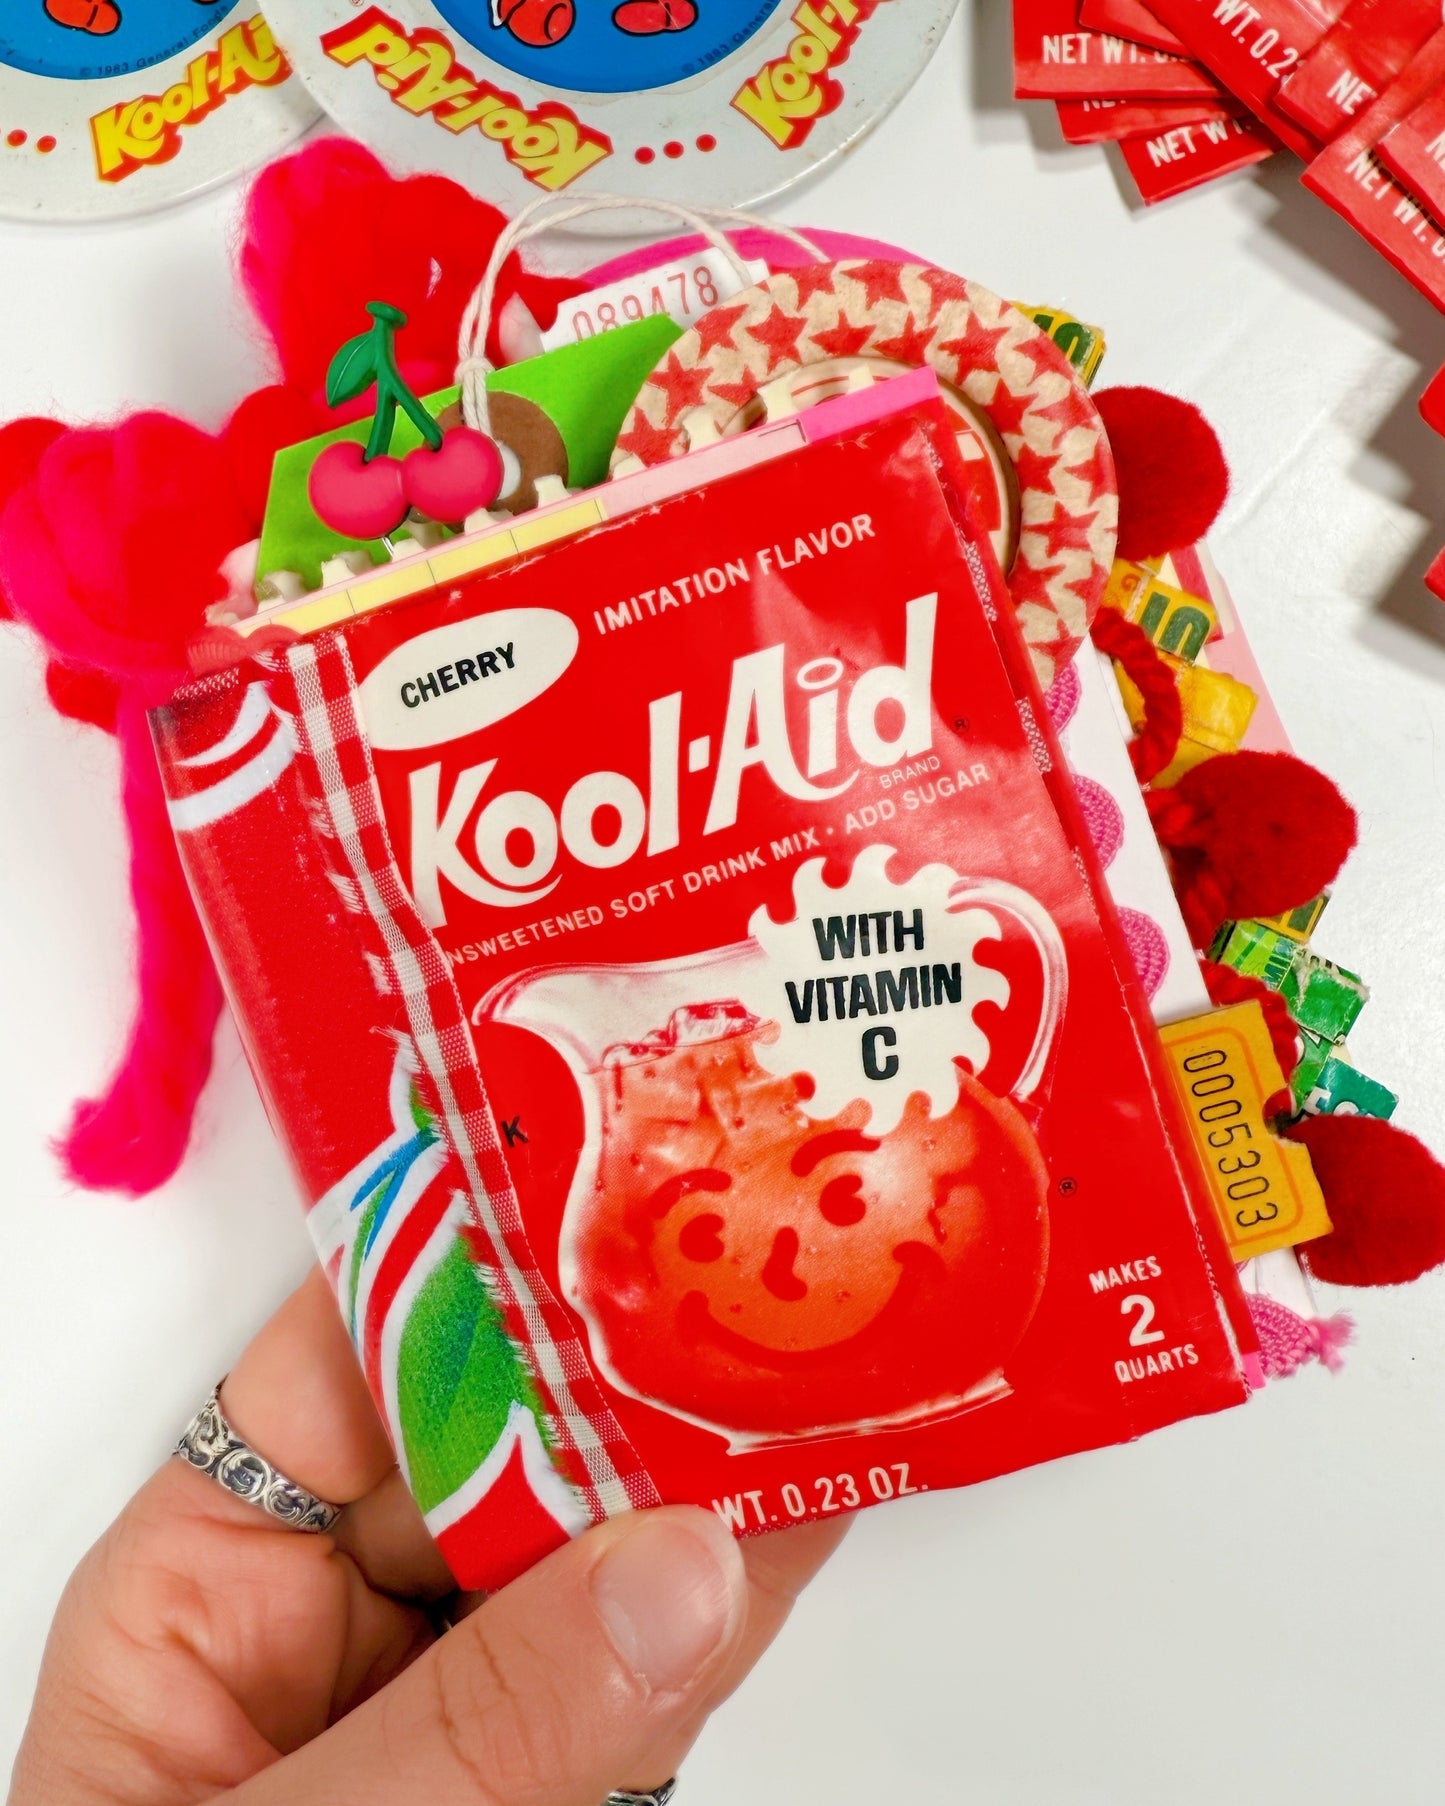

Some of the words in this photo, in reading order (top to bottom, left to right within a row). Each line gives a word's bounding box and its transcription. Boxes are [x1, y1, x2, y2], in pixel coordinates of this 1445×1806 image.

[97, 61, 130, 76] 1983
[135, 38, 190, 68] General
[191, 5, 228, 39] Foods
[1042, 32, 1092, 64] NET
[1212, 0, 1262, 44] WT.
[1250, 28, 1306, 87] 0.2
[92, 12, 290, 181] Kool-Ai
[321, 8, 612, 191] Kool-Aid
[1326, 69, 1378, 116] NE
[1146, 126, 1197, 168] NET
[593, 556, 748, 636] IMITATION
[756, 513, 876, 576] FLAVOR
[400, 641, 517, 710] CHERRY
[408, 591, 938, 928] Kool-Aid
[880, 755, 941, 789] BRAND
[445, 905, 605, 968] NSWEETENED
[612, 879, 677, 920] SOFT
[685, 850, 766, 893] DRINK
[770, 827, 820, 861] MIX
[844, 799, 896, 835] ADD
[902, 762, 991, 811] SUGAR
[811, 908, 925, 961] WITH
[784, 962, 963, 1024] VITAMIN
[861, 1027, 899, 1081] C
[500, 1114, 530, 1149] K
[1182, 1048, 1280, 1229] 0005303
[1088, 1255, 1163, 1295] MAKES
[1119, 1294, 1166, 1347] 2
[1113, 1343, 1200, 1384] QUARTS
[711, 1489, 778, 1533] WT.
[780, 1472, 861, 1518] 0.23
[868, 1462, 929, 1501] OZ.
